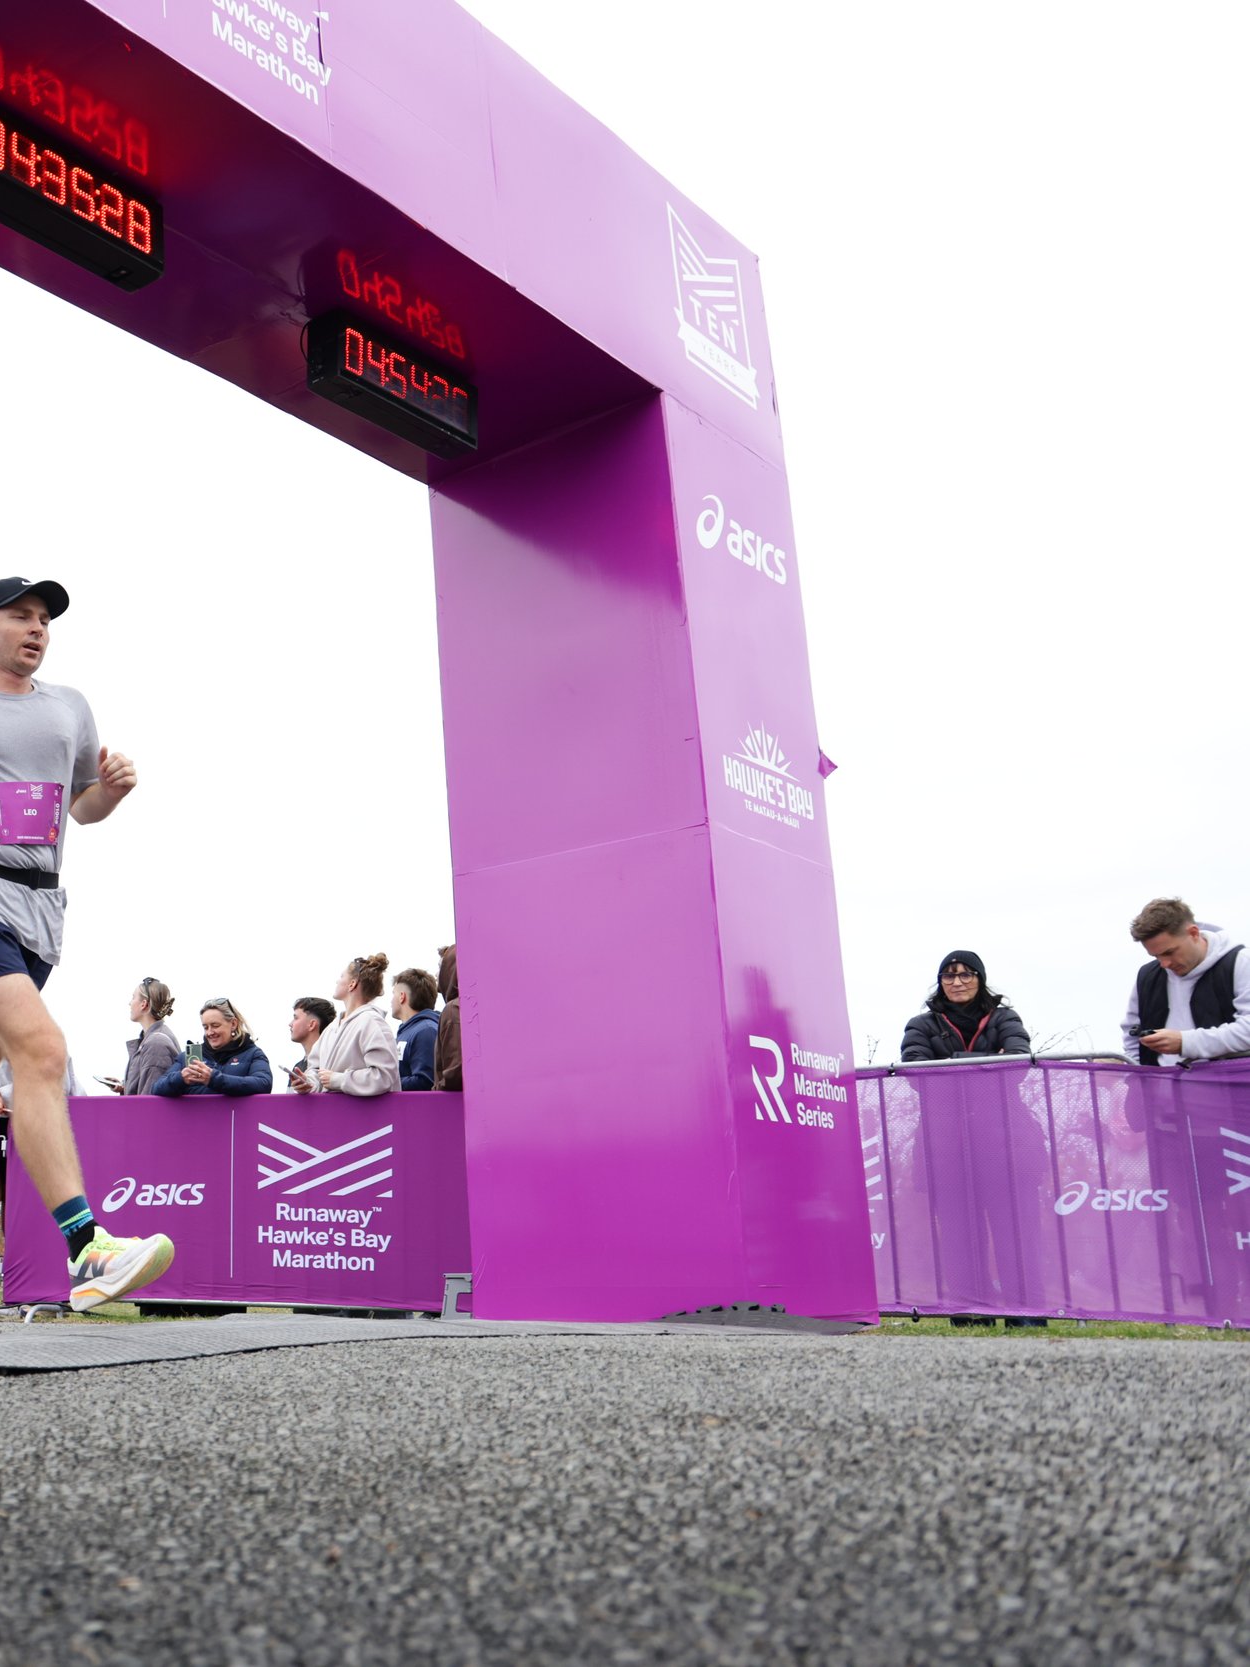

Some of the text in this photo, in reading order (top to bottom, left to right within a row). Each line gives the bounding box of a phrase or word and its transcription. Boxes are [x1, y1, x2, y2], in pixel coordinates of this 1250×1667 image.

[212, 10, 319, 105] Marathon
[292, 38, 332, 86] Bay
[689, 294, 737, 354] TEN
[723, 754, 815, 821] HAWKE'S BAY
[23, 808, 38, 816] LEO
[793, 1072, 848, 1103] Marathon
[796, 1102, 835, 1130] Series
[257, 1225, 392, 1253] Hawke's Bay
[272, 1249, 375, 1272] Marathon
